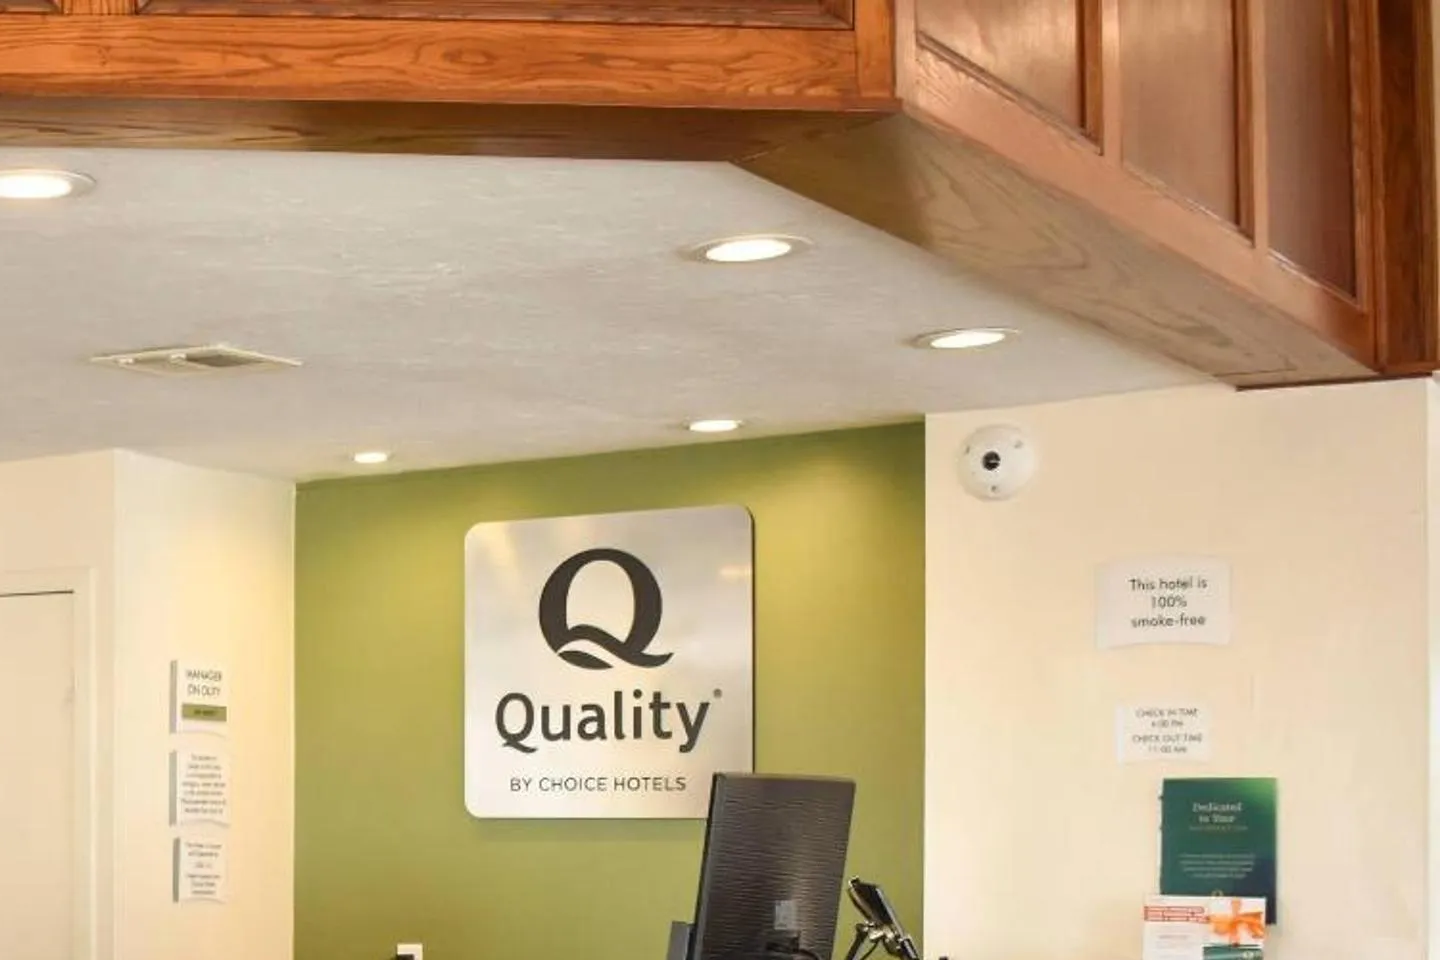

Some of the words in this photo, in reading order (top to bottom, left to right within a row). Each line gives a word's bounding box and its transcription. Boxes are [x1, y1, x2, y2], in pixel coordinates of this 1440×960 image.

[1128, 578, 1156, 591] This
[1158, 575, 1193, 590] hotel
[1197, 576, 1208, 589] is
[538, 547, 674, 671] Q
[1151, 595, 1188, 609] 100%
[1130, 612, 1207, 629] smoke-free
[185, 669, 223, 681] MANAGER
[495, 689, 710, 753] Quality
[509, 777, 532, 792] BY
[538, 776, 608, 792] CHOICE
[613, 776, 687, 791] HOTELS
